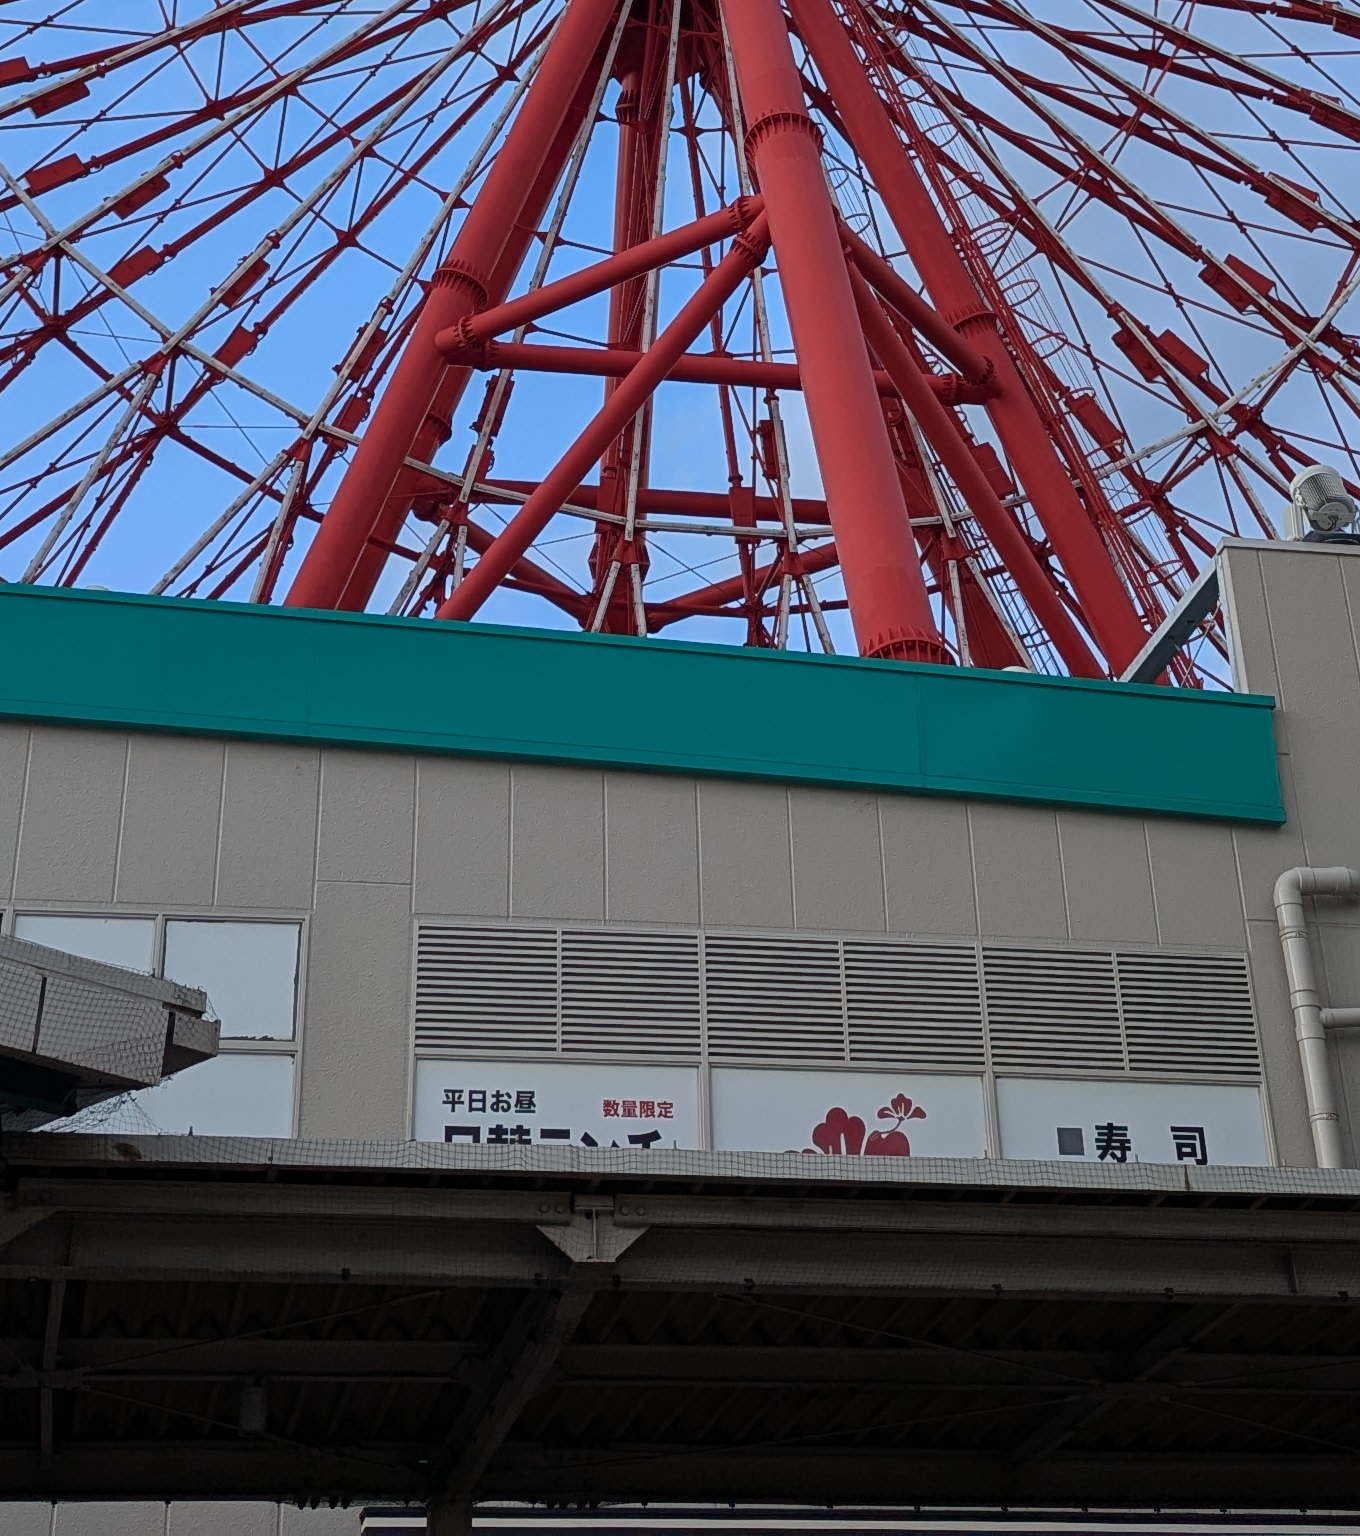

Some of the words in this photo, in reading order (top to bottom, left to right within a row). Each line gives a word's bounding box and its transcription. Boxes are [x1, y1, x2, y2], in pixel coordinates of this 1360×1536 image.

[442, 1088, 537, 1114] 平日お昼
[602, 1099, 675, 1119] 数量限定
